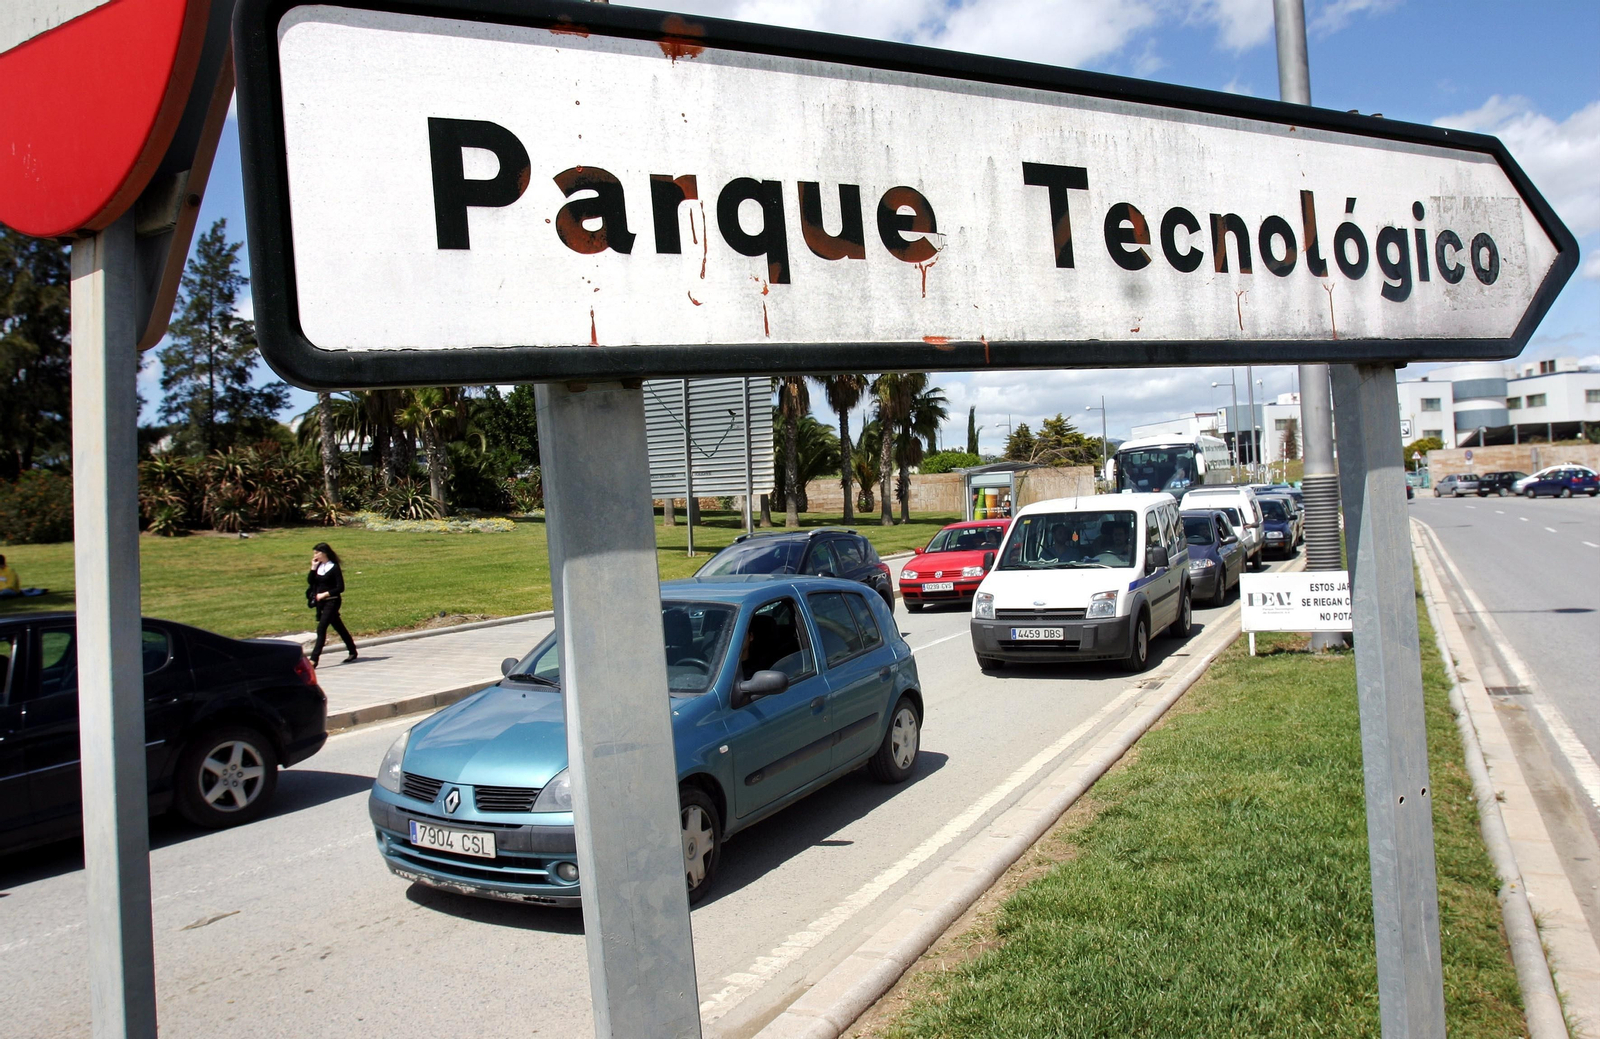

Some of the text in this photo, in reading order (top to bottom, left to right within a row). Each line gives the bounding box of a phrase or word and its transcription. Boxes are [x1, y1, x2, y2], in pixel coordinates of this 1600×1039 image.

[427, 116, 1500, 302] Parque Tecnológico
[1310, 583, 1334, 591] ESTOS
[1302, 598, 1311, 606] SE
[1314, 598, 1342, 606] RIEGAN
[1320, 612, 1331, 621] NO
[1018, 628, 1061, 639] 4459 DBS
[419, 825, 491, 856] 7904 CSL
